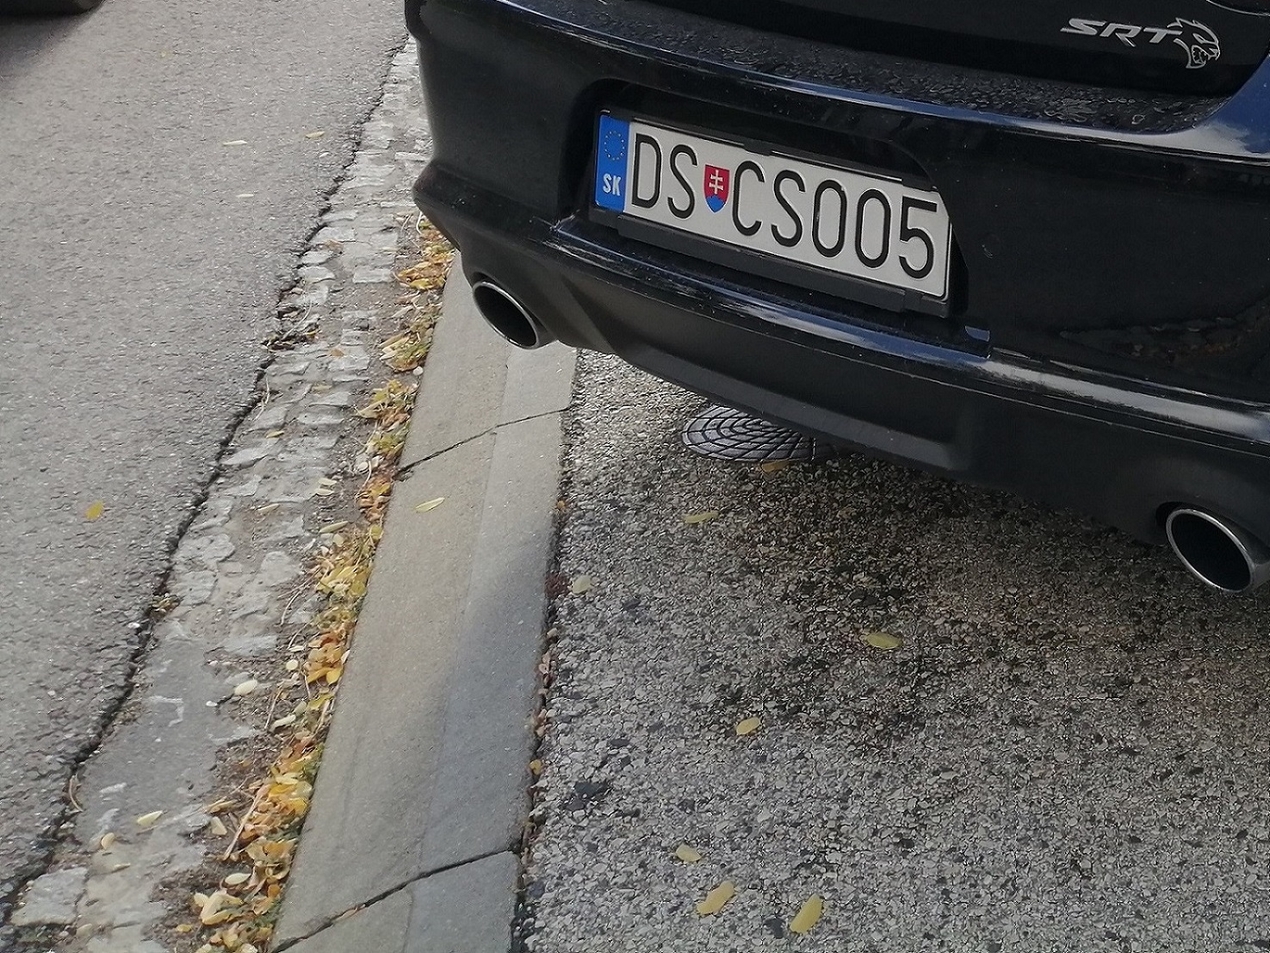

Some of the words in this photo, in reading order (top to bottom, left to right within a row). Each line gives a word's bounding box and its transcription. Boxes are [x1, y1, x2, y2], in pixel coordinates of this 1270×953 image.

[1060, 17, 1183, 48] SRT
[602, 172, 622, 197] SK
[631, 132, 698, 220] DS
